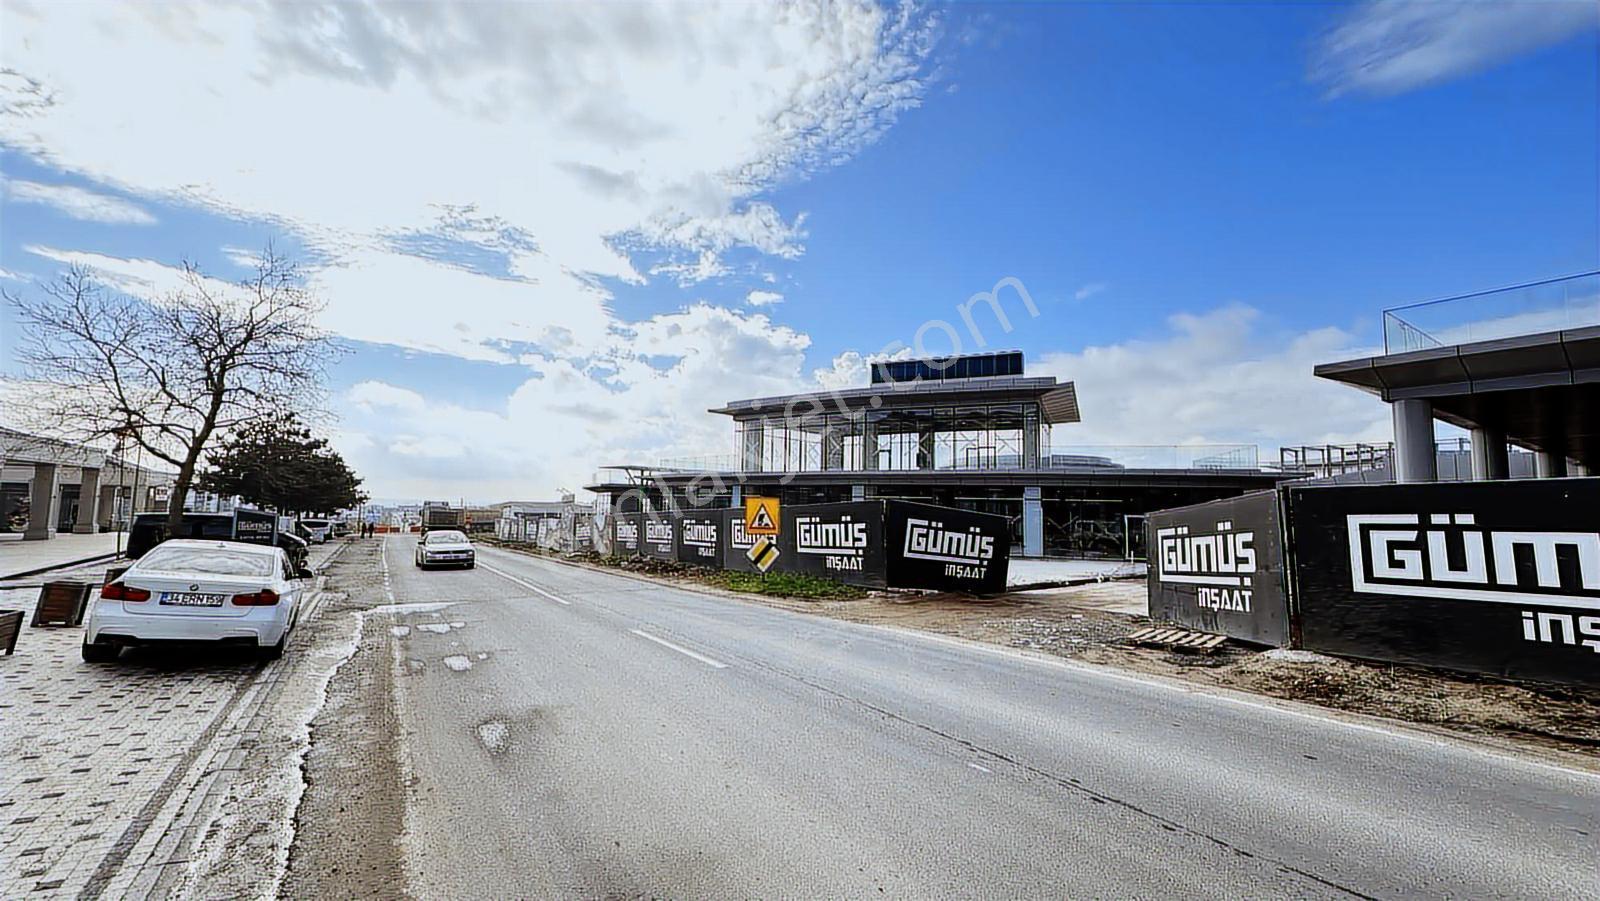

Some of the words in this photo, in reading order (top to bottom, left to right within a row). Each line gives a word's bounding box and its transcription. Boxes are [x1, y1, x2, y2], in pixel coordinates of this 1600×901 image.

[797, 516, 867, 555] GÜMÜŞ
[903, 517, 995, 566] GÜMÜŞ
[1158, 522, 1256, 586] GÜMÜŞ
